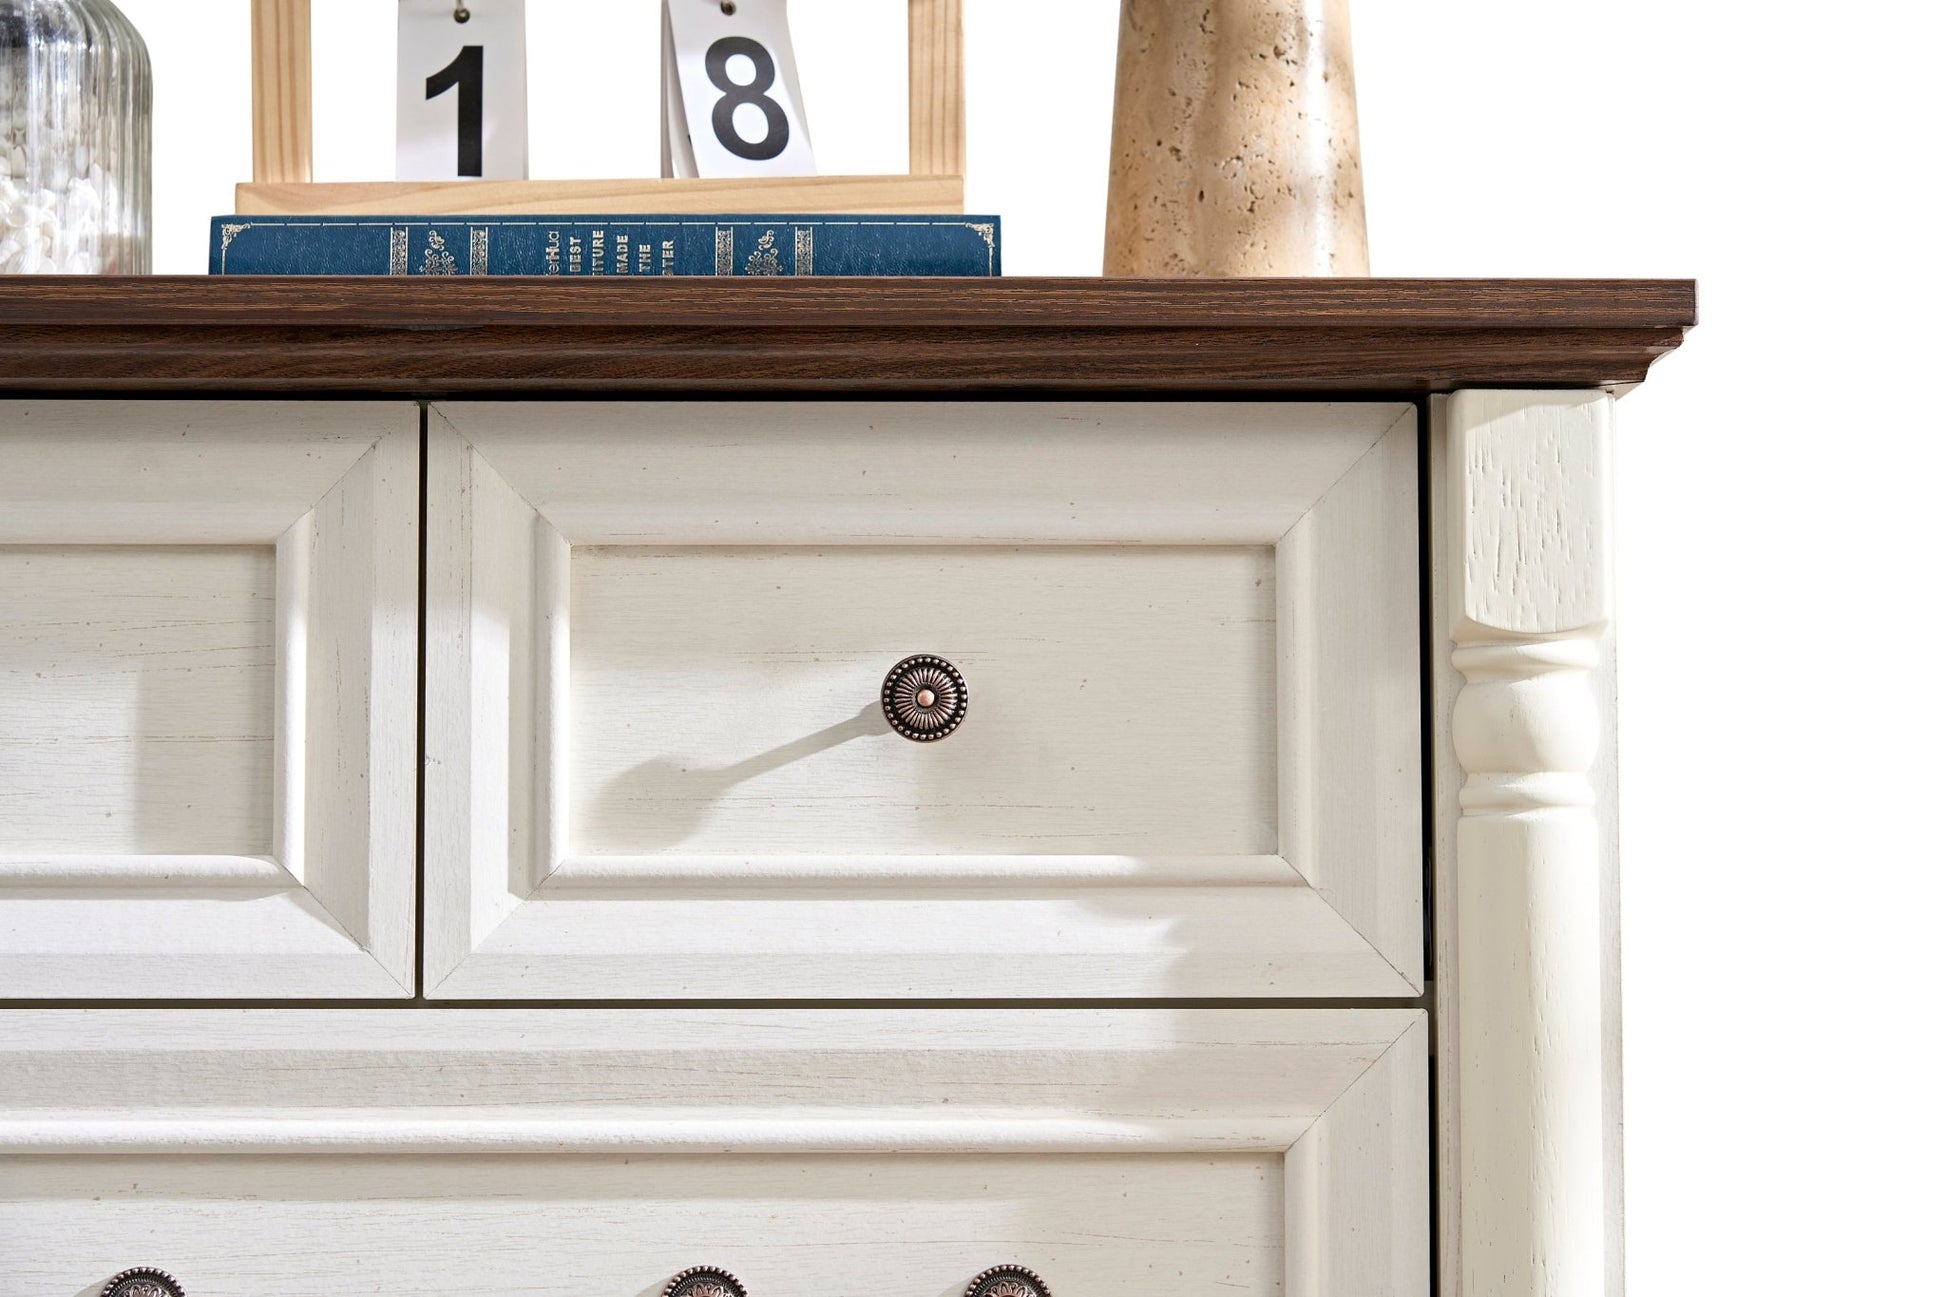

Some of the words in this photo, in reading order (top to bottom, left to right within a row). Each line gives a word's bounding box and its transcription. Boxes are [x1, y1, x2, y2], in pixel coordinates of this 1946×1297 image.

[425, 45, 484, 178] 1
[704, 35, 790, 161] 8
[545, 230, 560, 276] erHua
[569, 236, 582, 273] BEST
[616, 234, 629, 274] MADE
[638, 244, 651, 273] THE
